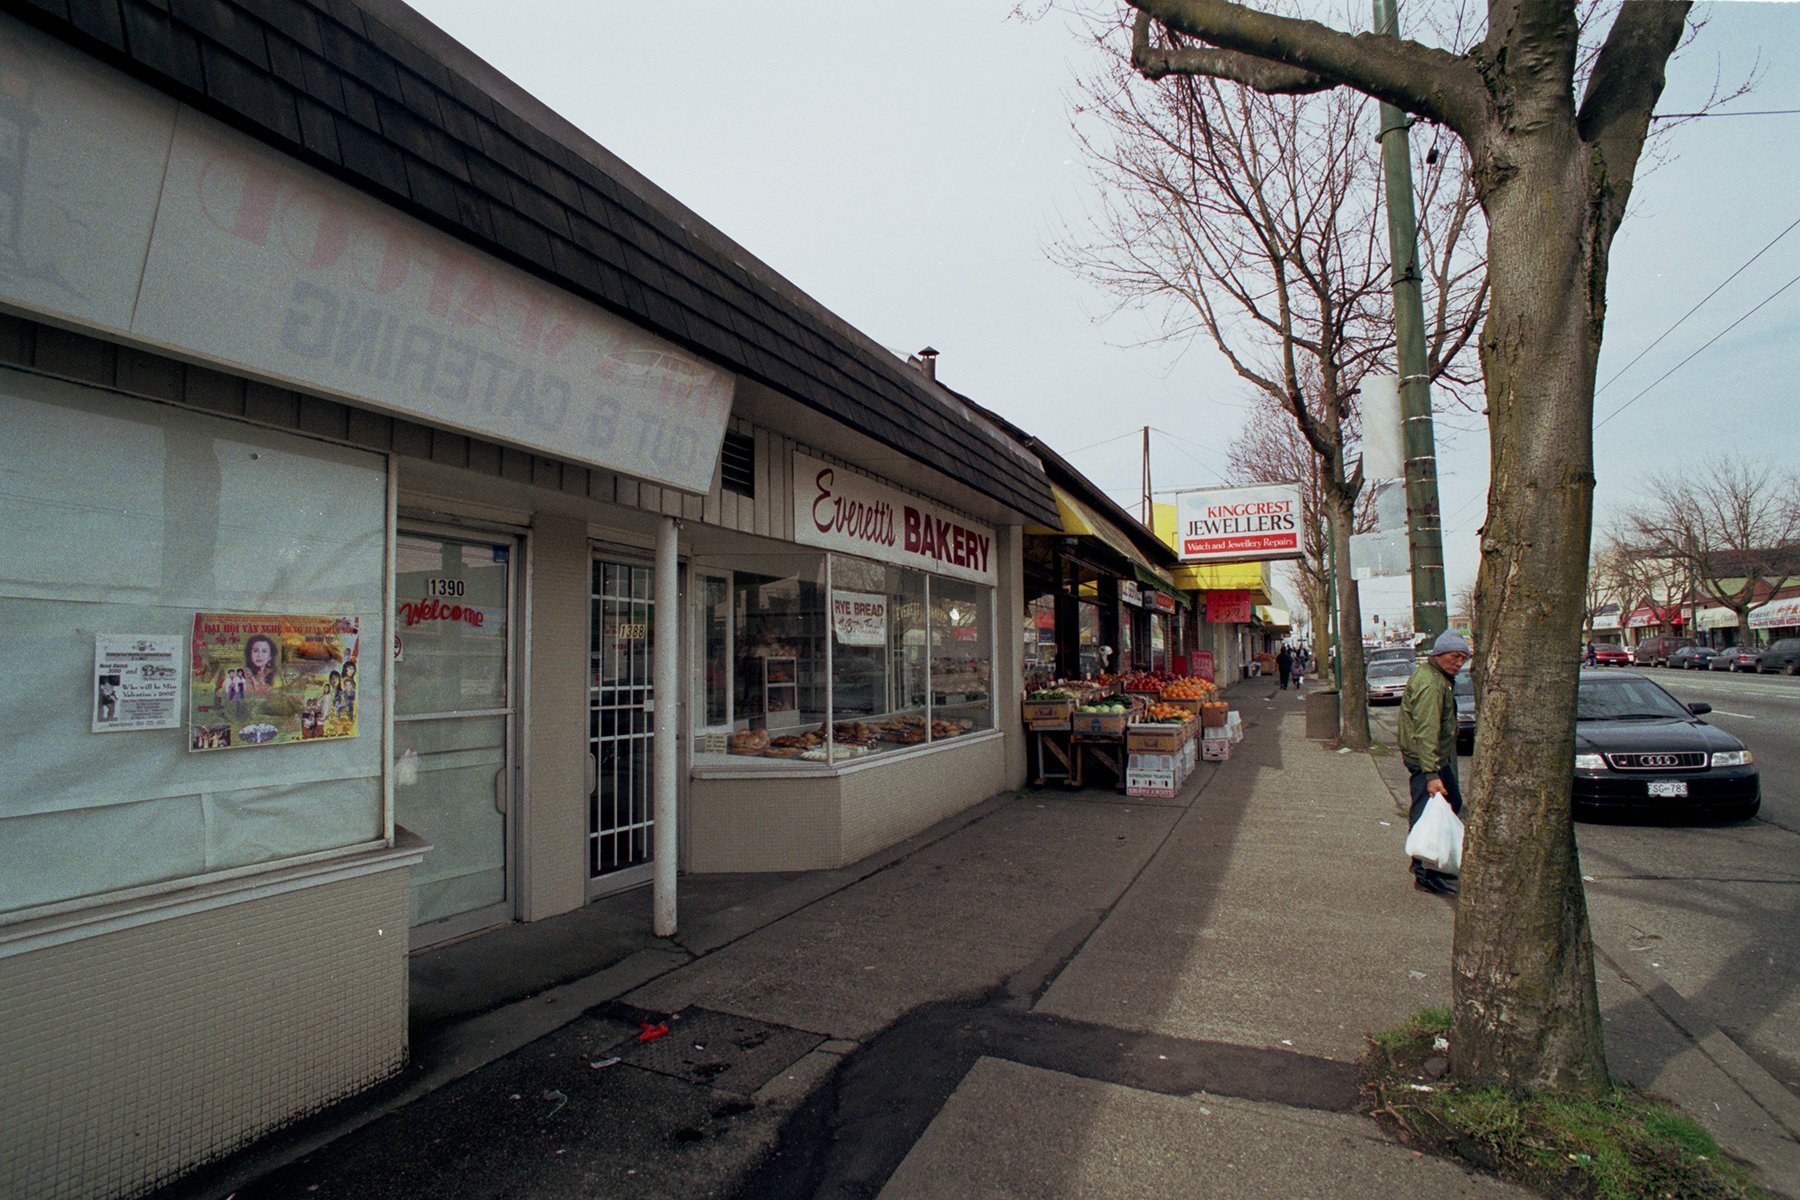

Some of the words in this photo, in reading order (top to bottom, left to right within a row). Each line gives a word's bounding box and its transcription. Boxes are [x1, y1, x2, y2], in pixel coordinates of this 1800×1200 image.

[1207, 500, 1293, 519] KINGCREST
[813, 468, 896, 548] Everett's
[904, 505, 990, 573] BAKERY
[1186, 514, 1295, 536] JEWELLERS
[1187, 541, 1211, 551] Watch
[1212, 540, 1226, 549] and
[1227, 539, 1263, 550] Jewellery
[1263, 537, 1294, 548] Repairs
[431, 579, 465, 597] 1390
[399, 596, 484, 627] Welcome
[834, 600, 851, 616] RYE
[854, 601, 884, 617] BREAD
[620, 624, 645, 638] 1388
